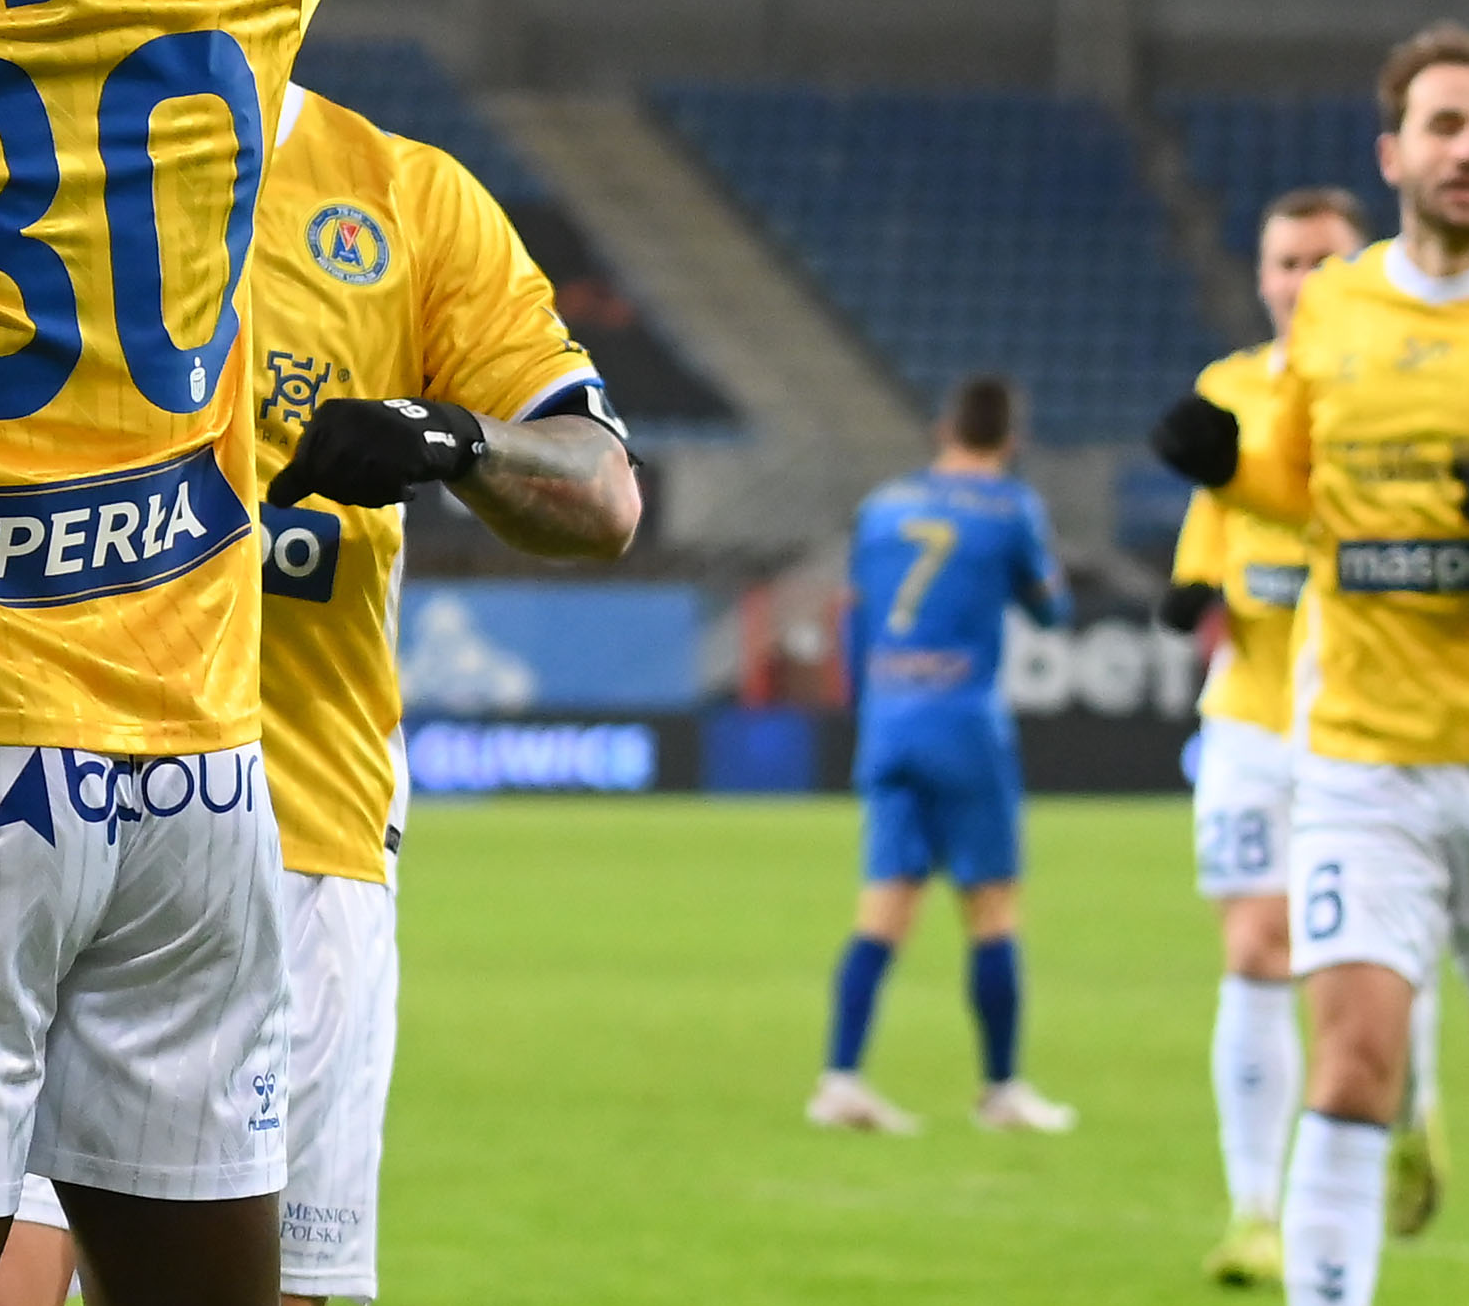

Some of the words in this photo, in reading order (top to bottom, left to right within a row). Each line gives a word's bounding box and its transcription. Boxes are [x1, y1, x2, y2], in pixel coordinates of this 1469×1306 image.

[887, 517, 957, 635] 7
[1305, 862, 1345, 942] 6
[280, 1221, 343, 1244] POLSKA
[283, 1201, 361, 1226] MENNICA
